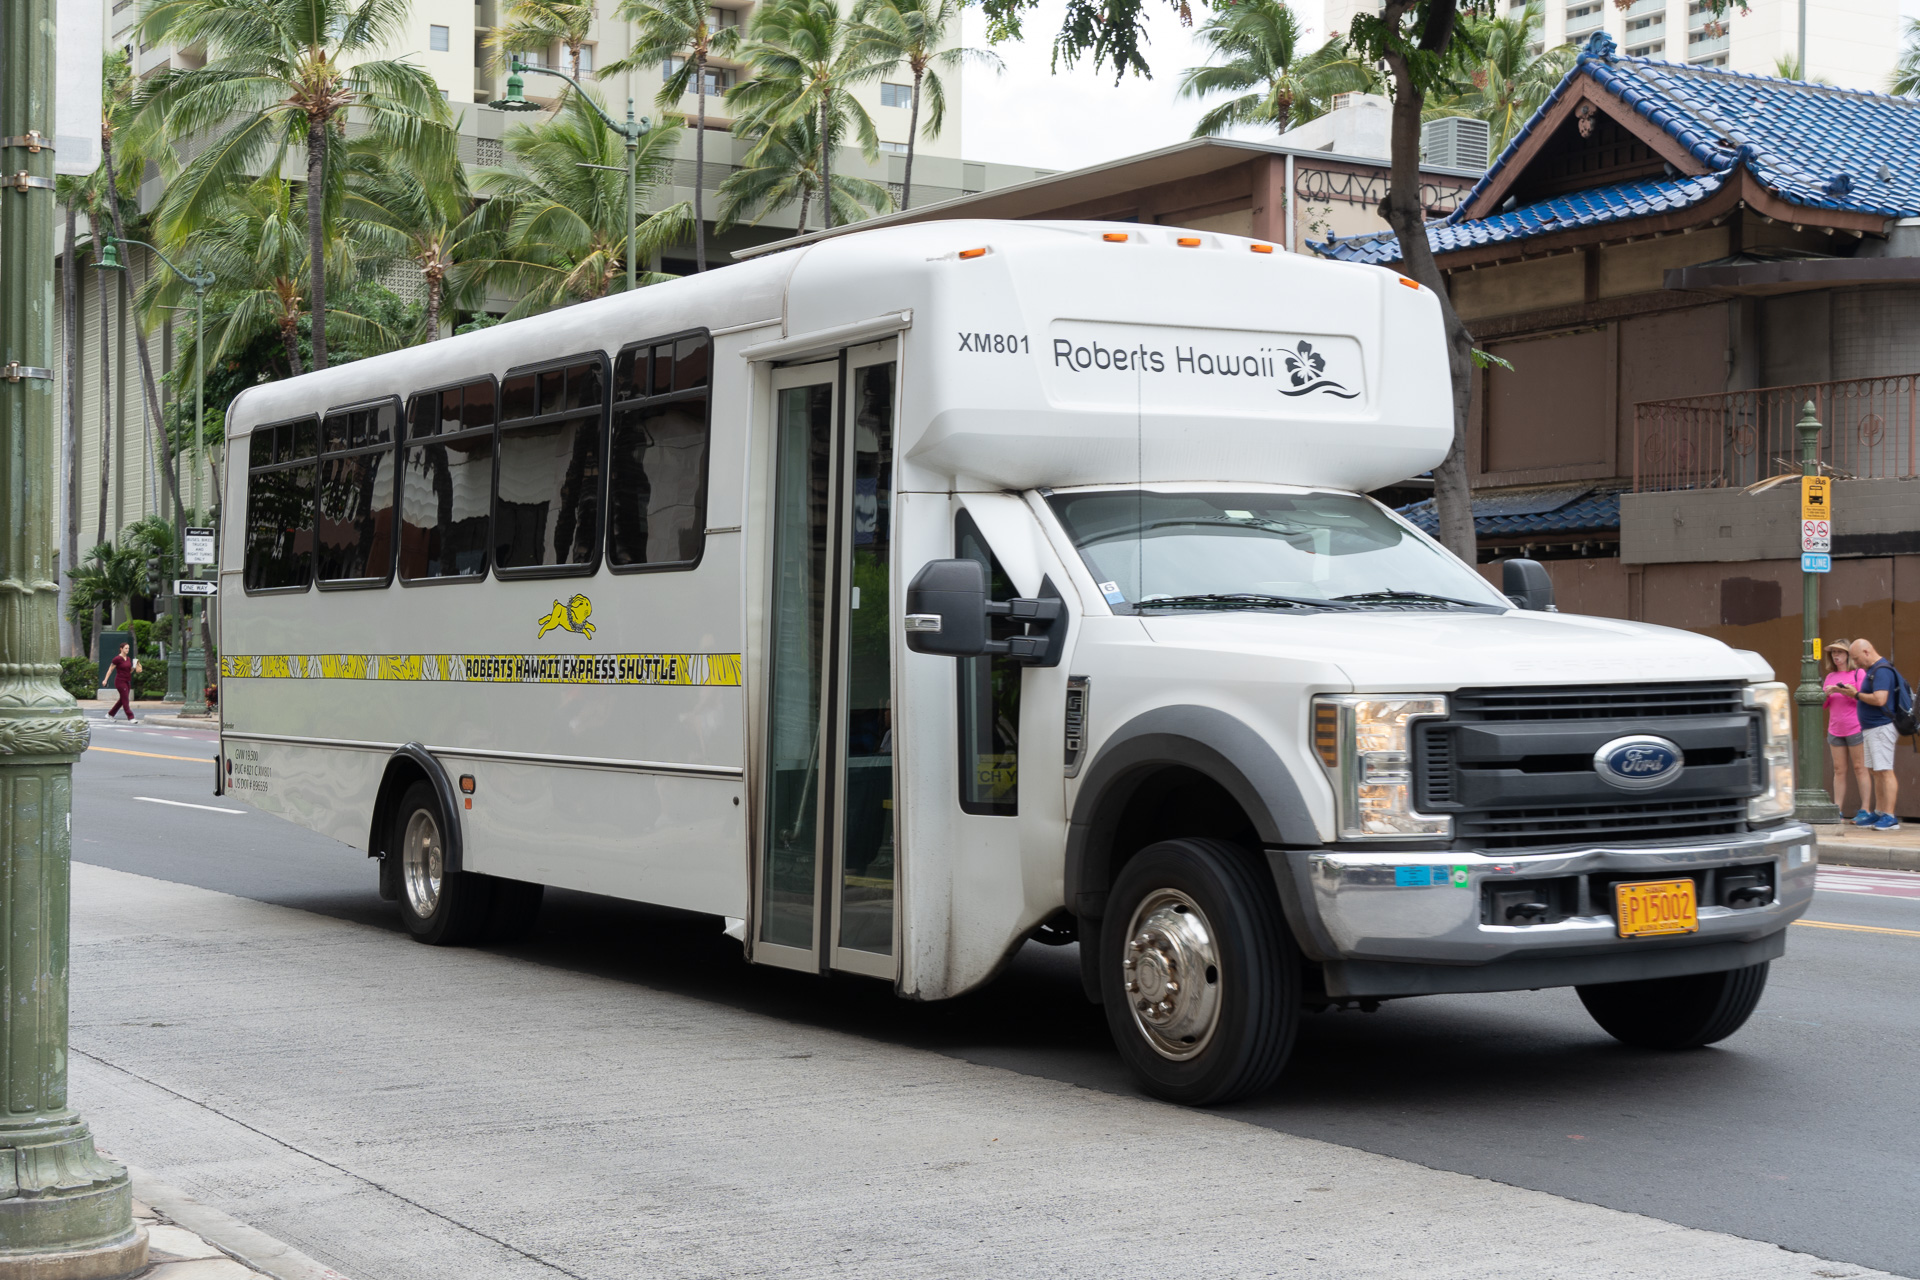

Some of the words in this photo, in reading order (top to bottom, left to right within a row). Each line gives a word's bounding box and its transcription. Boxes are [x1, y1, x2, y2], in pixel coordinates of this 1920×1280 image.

[957, 332, 1030, 355] XM801
[1053, 338, 1165, 373] Roberts
[1176, 345, 1274, 379] Hawaii
[1805, 558, 1812, 568] W
[1812, 558, 1827, 568] LINE
[1104, 583, 1115, 592] 6
[466, 658, 513, 678] ROBERTS
[515, 658, 560, 679] HAWAII
[562, 659, 616, 680] EXPRESS
[618, 659, 677, 681] SHUTTLE
[234, 763, 244, 775] PUC
[1622, 749, 1664, 772] Ford
[1629, 890, 1692, 924] P15002
